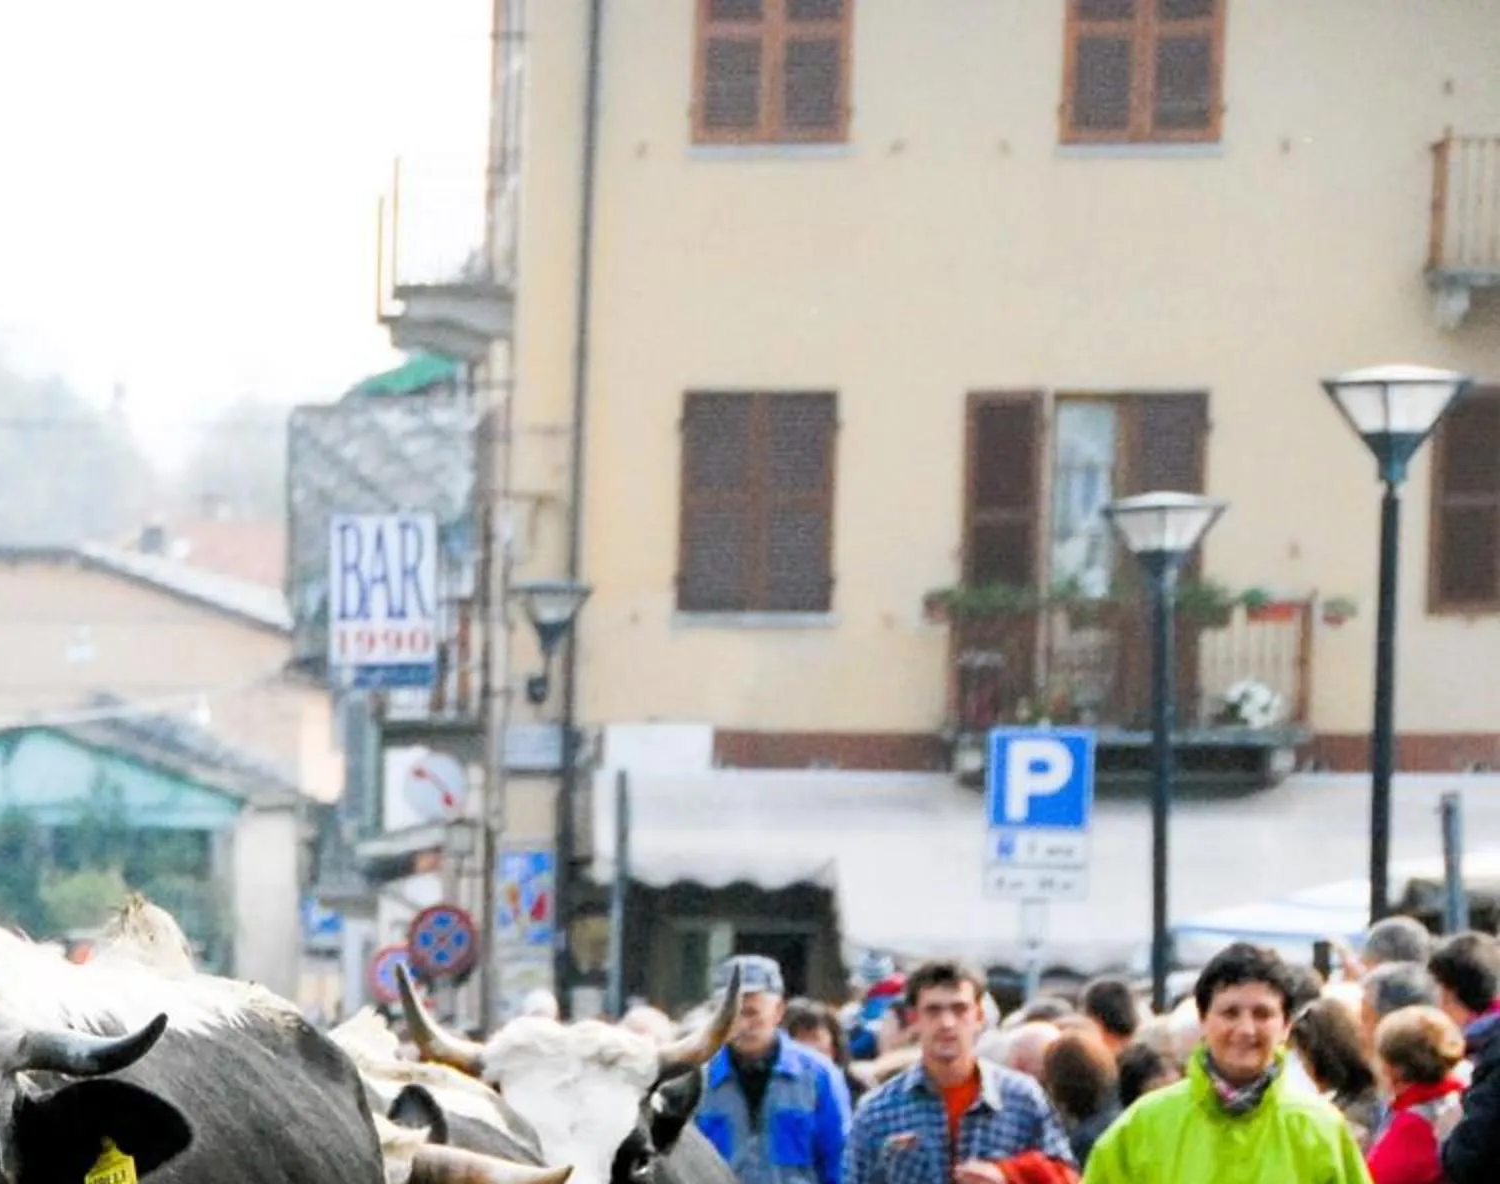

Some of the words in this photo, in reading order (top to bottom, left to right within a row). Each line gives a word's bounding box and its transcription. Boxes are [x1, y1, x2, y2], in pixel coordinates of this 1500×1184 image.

[338, 520, 433, 620] BAR
[338, 629, 431, 655] 1990
[1004, 737, 1075, 823] P
